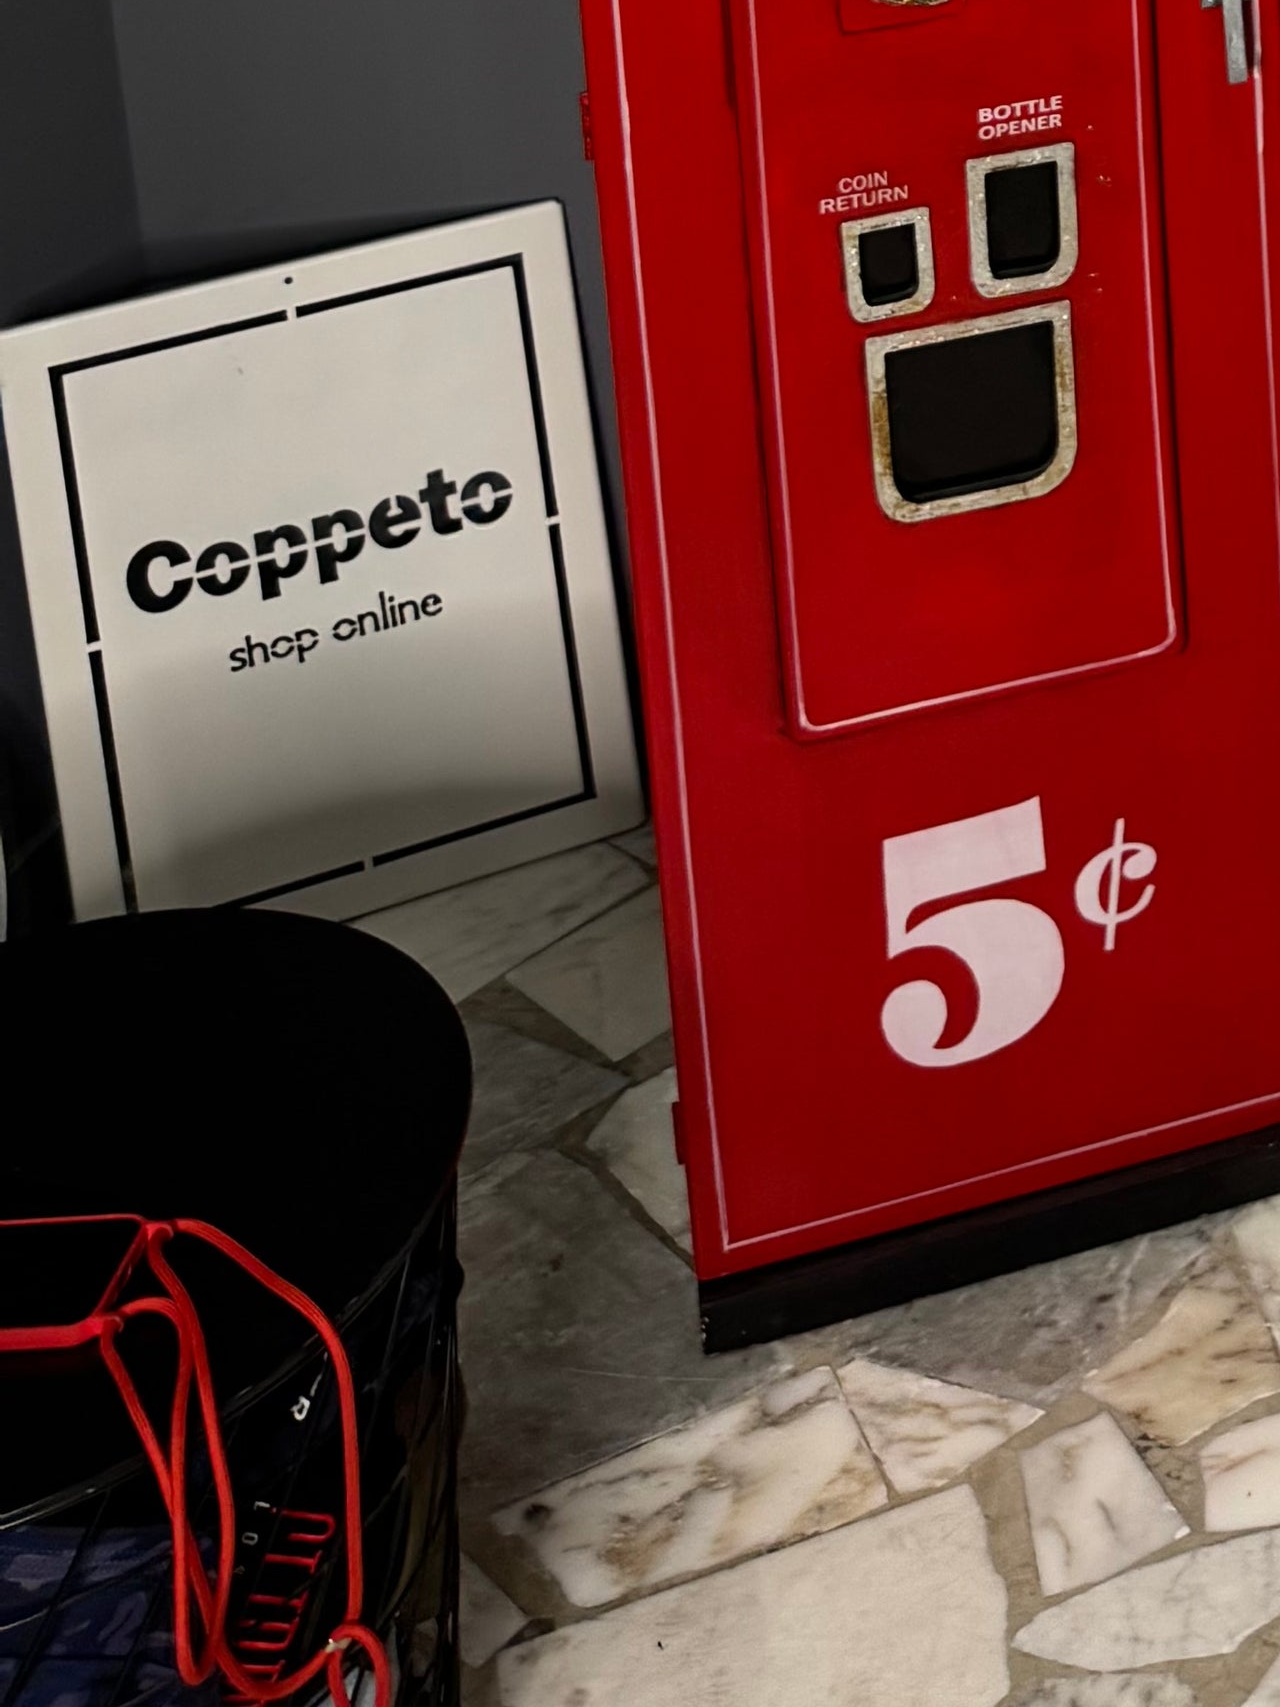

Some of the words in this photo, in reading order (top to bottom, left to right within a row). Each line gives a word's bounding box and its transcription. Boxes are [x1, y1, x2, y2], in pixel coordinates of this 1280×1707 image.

[978, 95, 1063, 124] BOTTLE
[978, 114, 1063, 141] OPENER
[838, 170, 888, 193] COIN
[819, 184, 909, 215] RETURN
[125, 469, 513, 613] Coppeto
[229, 627, 319, 673] shop
[332, 590, 443, 642] online
